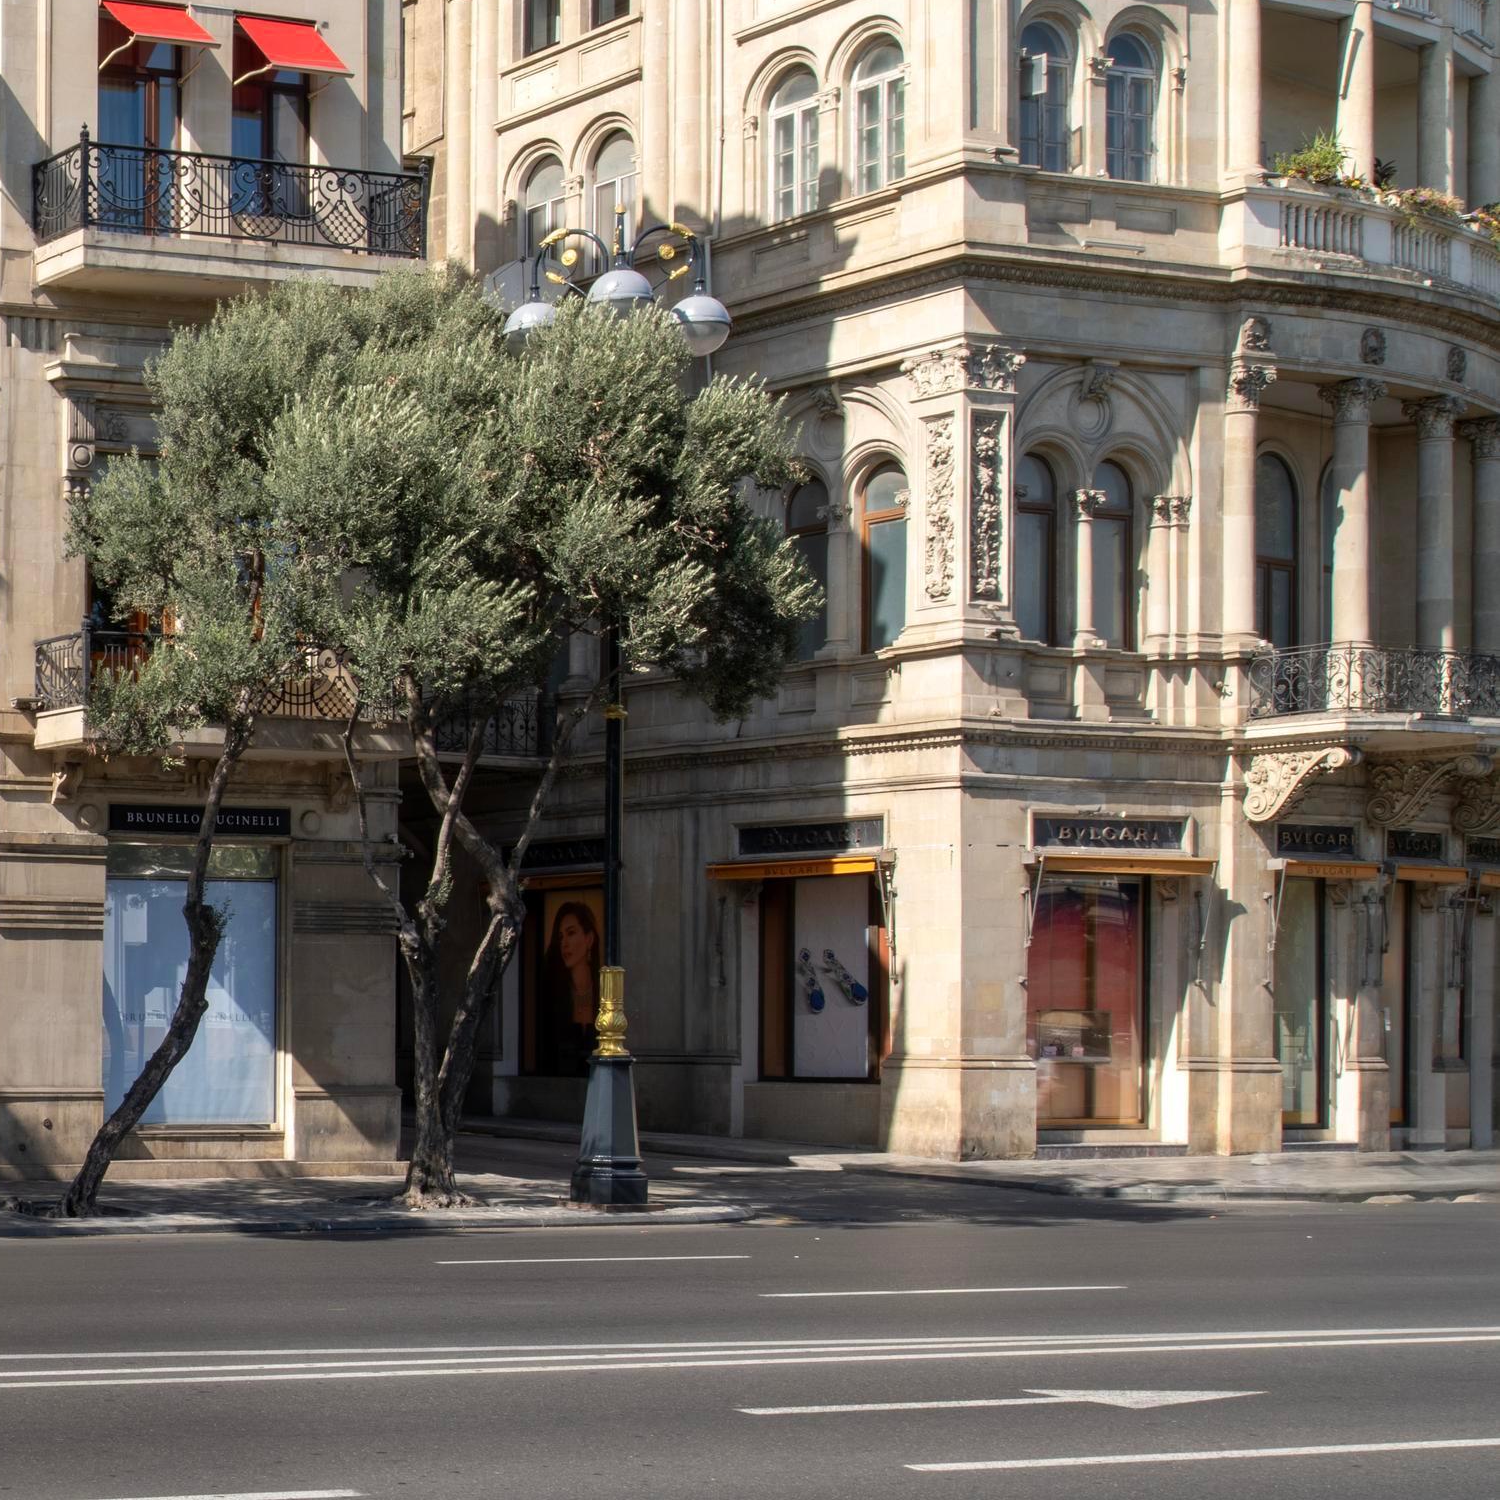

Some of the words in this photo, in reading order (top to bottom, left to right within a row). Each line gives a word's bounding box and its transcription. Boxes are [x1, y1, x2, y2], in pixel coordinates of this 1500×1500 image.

[127, 812, 200, 824] BRUNELLO
[215, 815, 280, 826] UCINELLI
[1059, 826, 1160, 840] BVLGARI
[1281, 831, 1357, 845] BVLGARI
[764, 865, 819, 876] BVLGARI
[1307, 866, 1358, 876] BVLGARI
